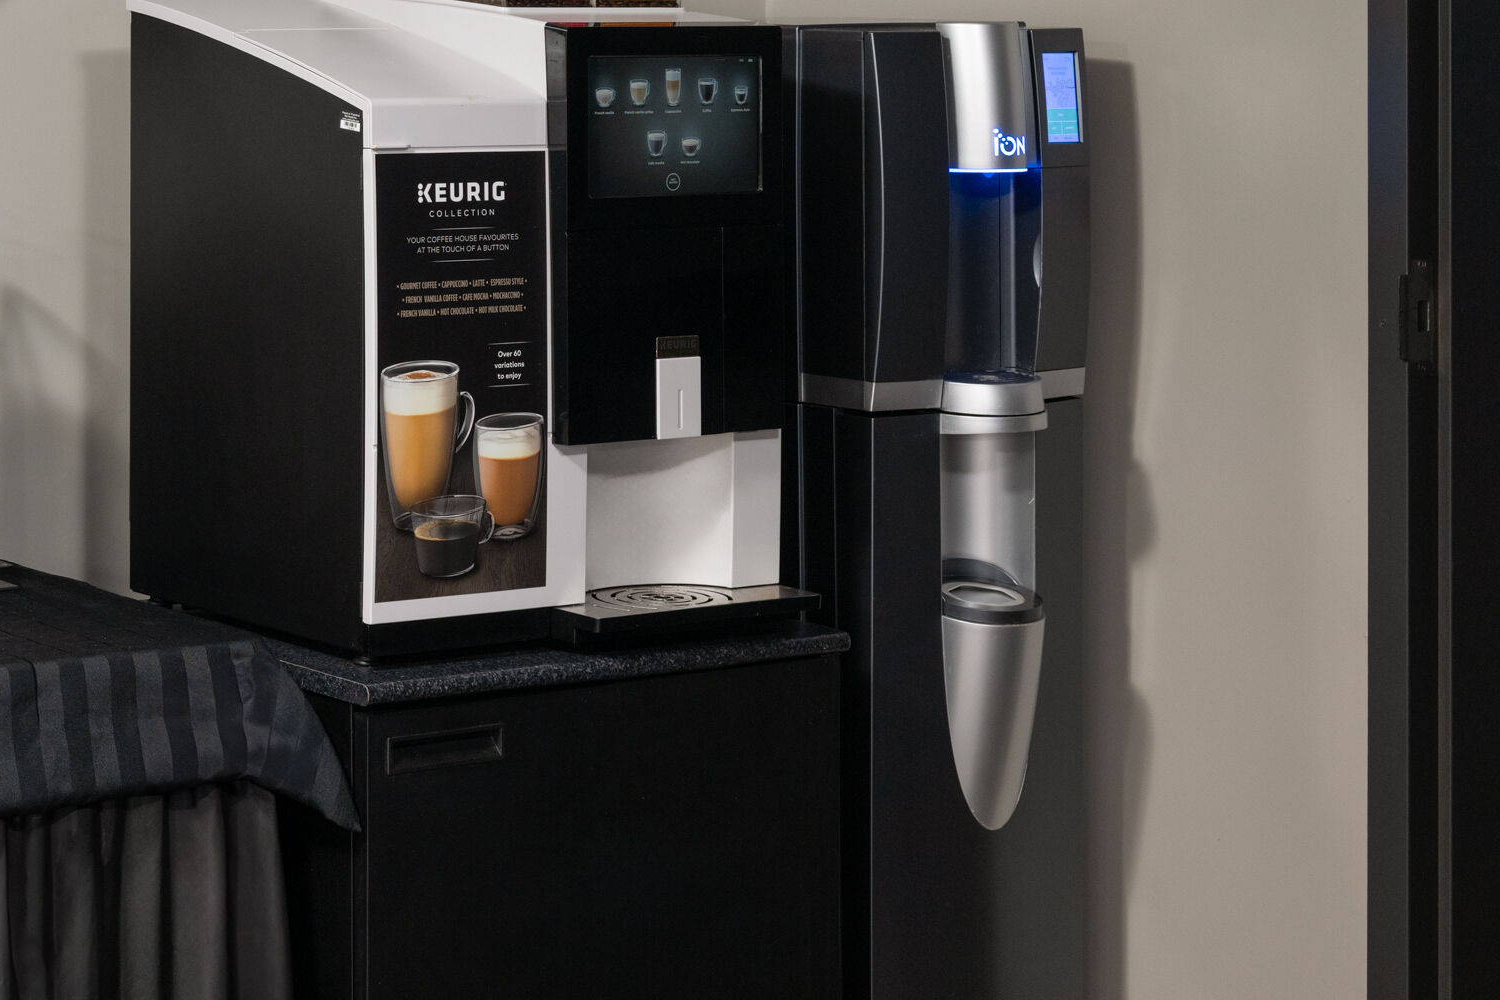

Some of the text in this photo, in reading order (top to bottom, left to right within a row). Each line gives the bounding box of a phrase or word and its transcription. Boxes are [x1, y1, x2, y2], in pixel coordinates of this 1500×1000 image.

[418, 181, 506, 203] KEURIG
[429, 208, 495, 218] COLLECTION
[426, 235, 453, 243] COFFEE
[455, 234, 477, 242] HOUSE
[479, 233, 519, 242] FAVOURITES
[427, 246, 440, 254] THE
[442, 245, 465, 253] TOUCH
[483, 244, 509, 252] BUTTON
[400, 277, 524, 290] GOURMET COFFEE CAPPUCCINO LATTE ESPRESSO STYLE
[424, 295, 442, 303] VANILLA
[443, 294, 458, 302] COFFEE
[473, 292, 489, 300] MOCHA
[493, 291, 520, 300] MOCHACCINO
[401, 310, 417, 318] FRENCH
[417, 309, 437, 317] VANILLA
[440, 308, 450, 316] HOT
[450, 307, 474, 315] CHOCOLATE
[499, 304, 523, 313] CHOCOLATE
[494, 361, 525, 369] variations
[506, 372, 522, 380] enjoy
